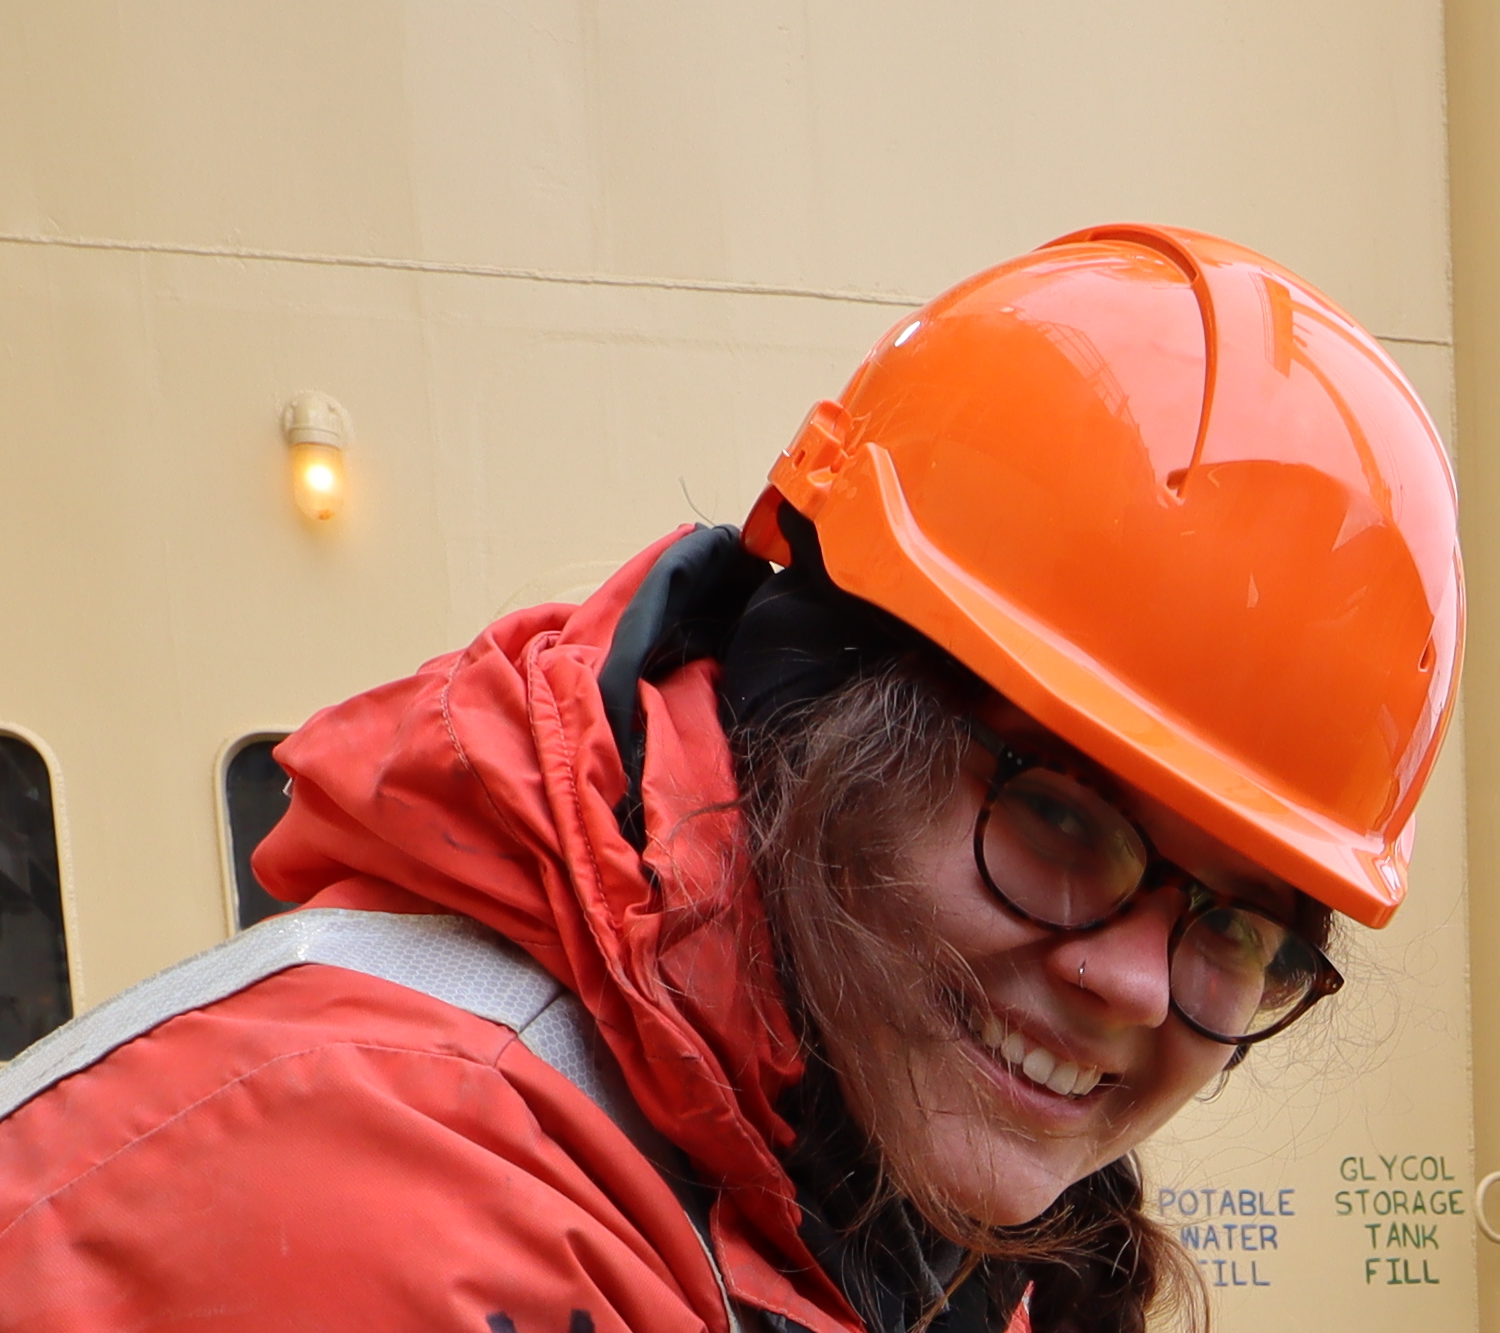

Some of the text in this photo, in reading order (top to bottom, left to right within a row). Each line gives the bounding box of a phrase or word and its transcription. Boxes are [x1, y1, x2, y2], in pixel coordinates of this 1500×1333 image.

[1340, 1156, 1454, 1181] GLYCOL
[1158, 1188, 1295, 1216] POTABLE
[1335, 1190, 1465, 1215] STORAGE
[1180, 1223, 1278, 1251] WATER
[1364, 1223, 1439, 1249] TANK
[1365, 1258, 1439, 1284] FILL
